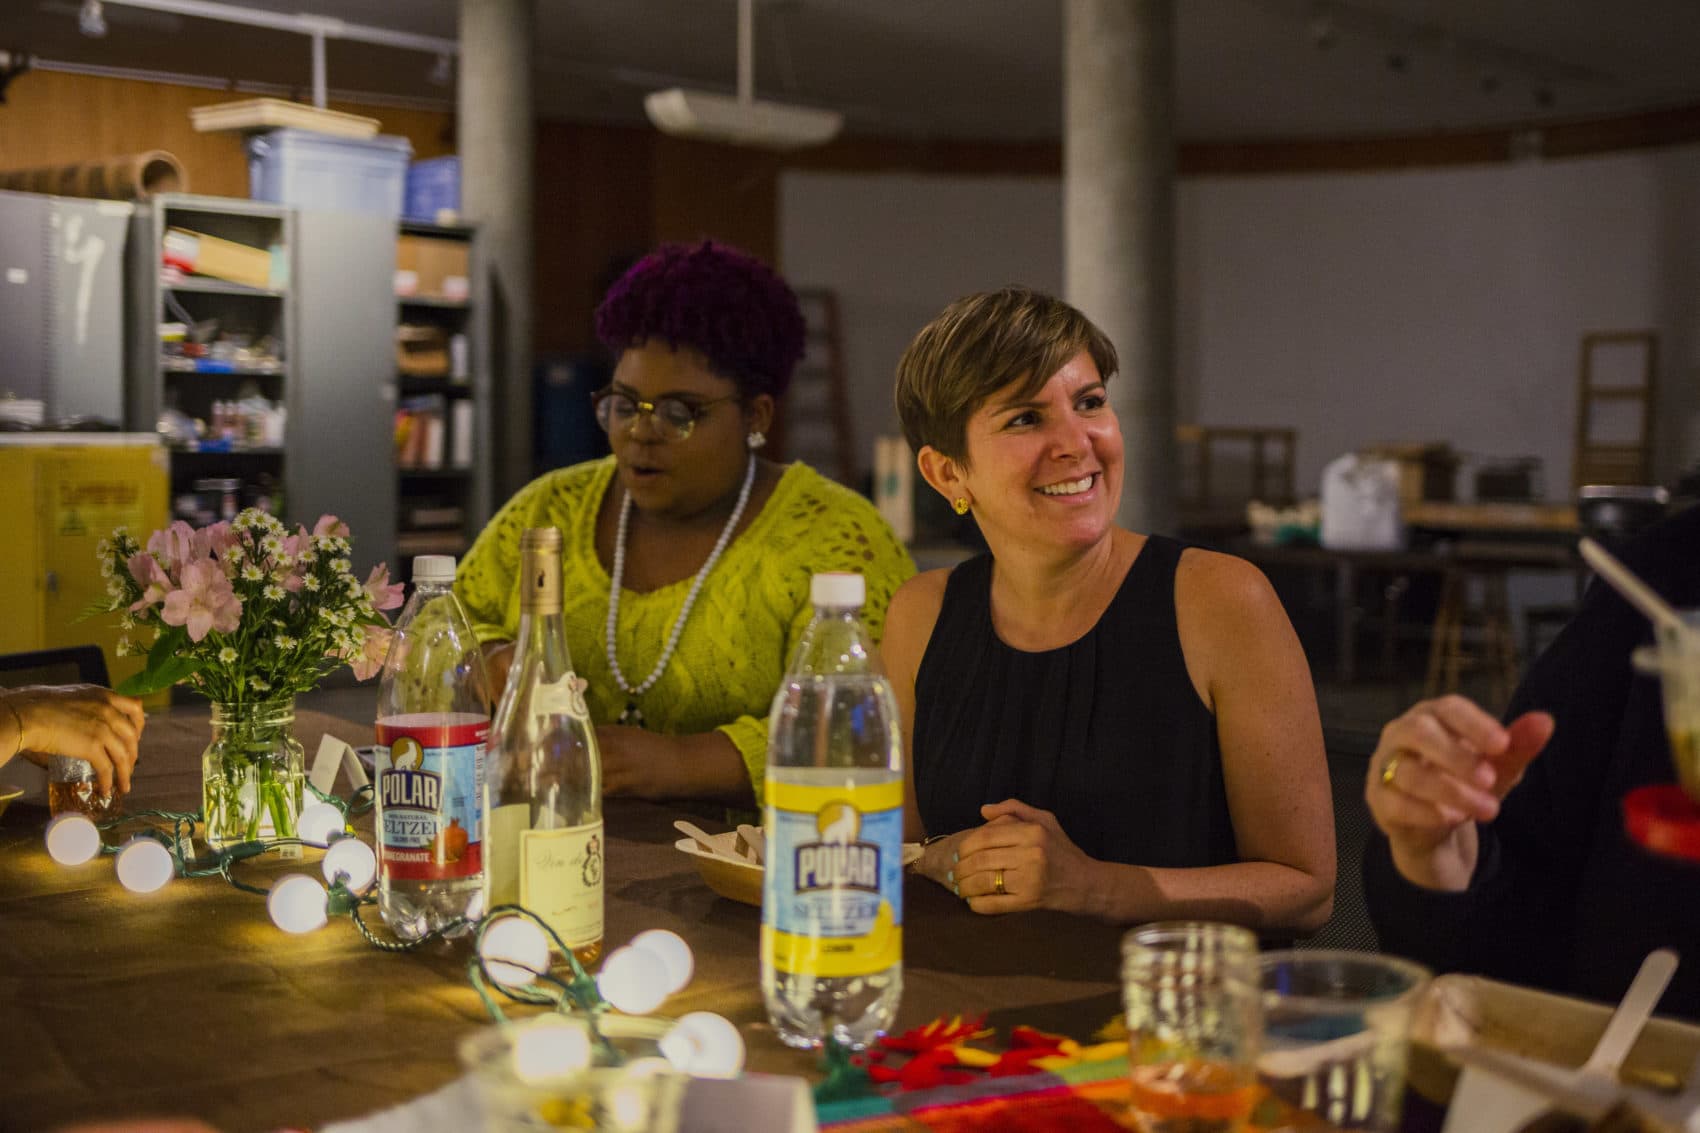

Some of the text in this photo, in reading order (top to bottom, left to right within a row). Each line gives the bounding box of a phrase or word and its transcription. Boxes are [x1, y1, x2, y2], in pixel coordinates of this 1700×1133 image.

[382, 773, 438, 809] POLAR
[383, 850, 431, 863] EGRANATE
[798, 845, 877, 889] POLAR
